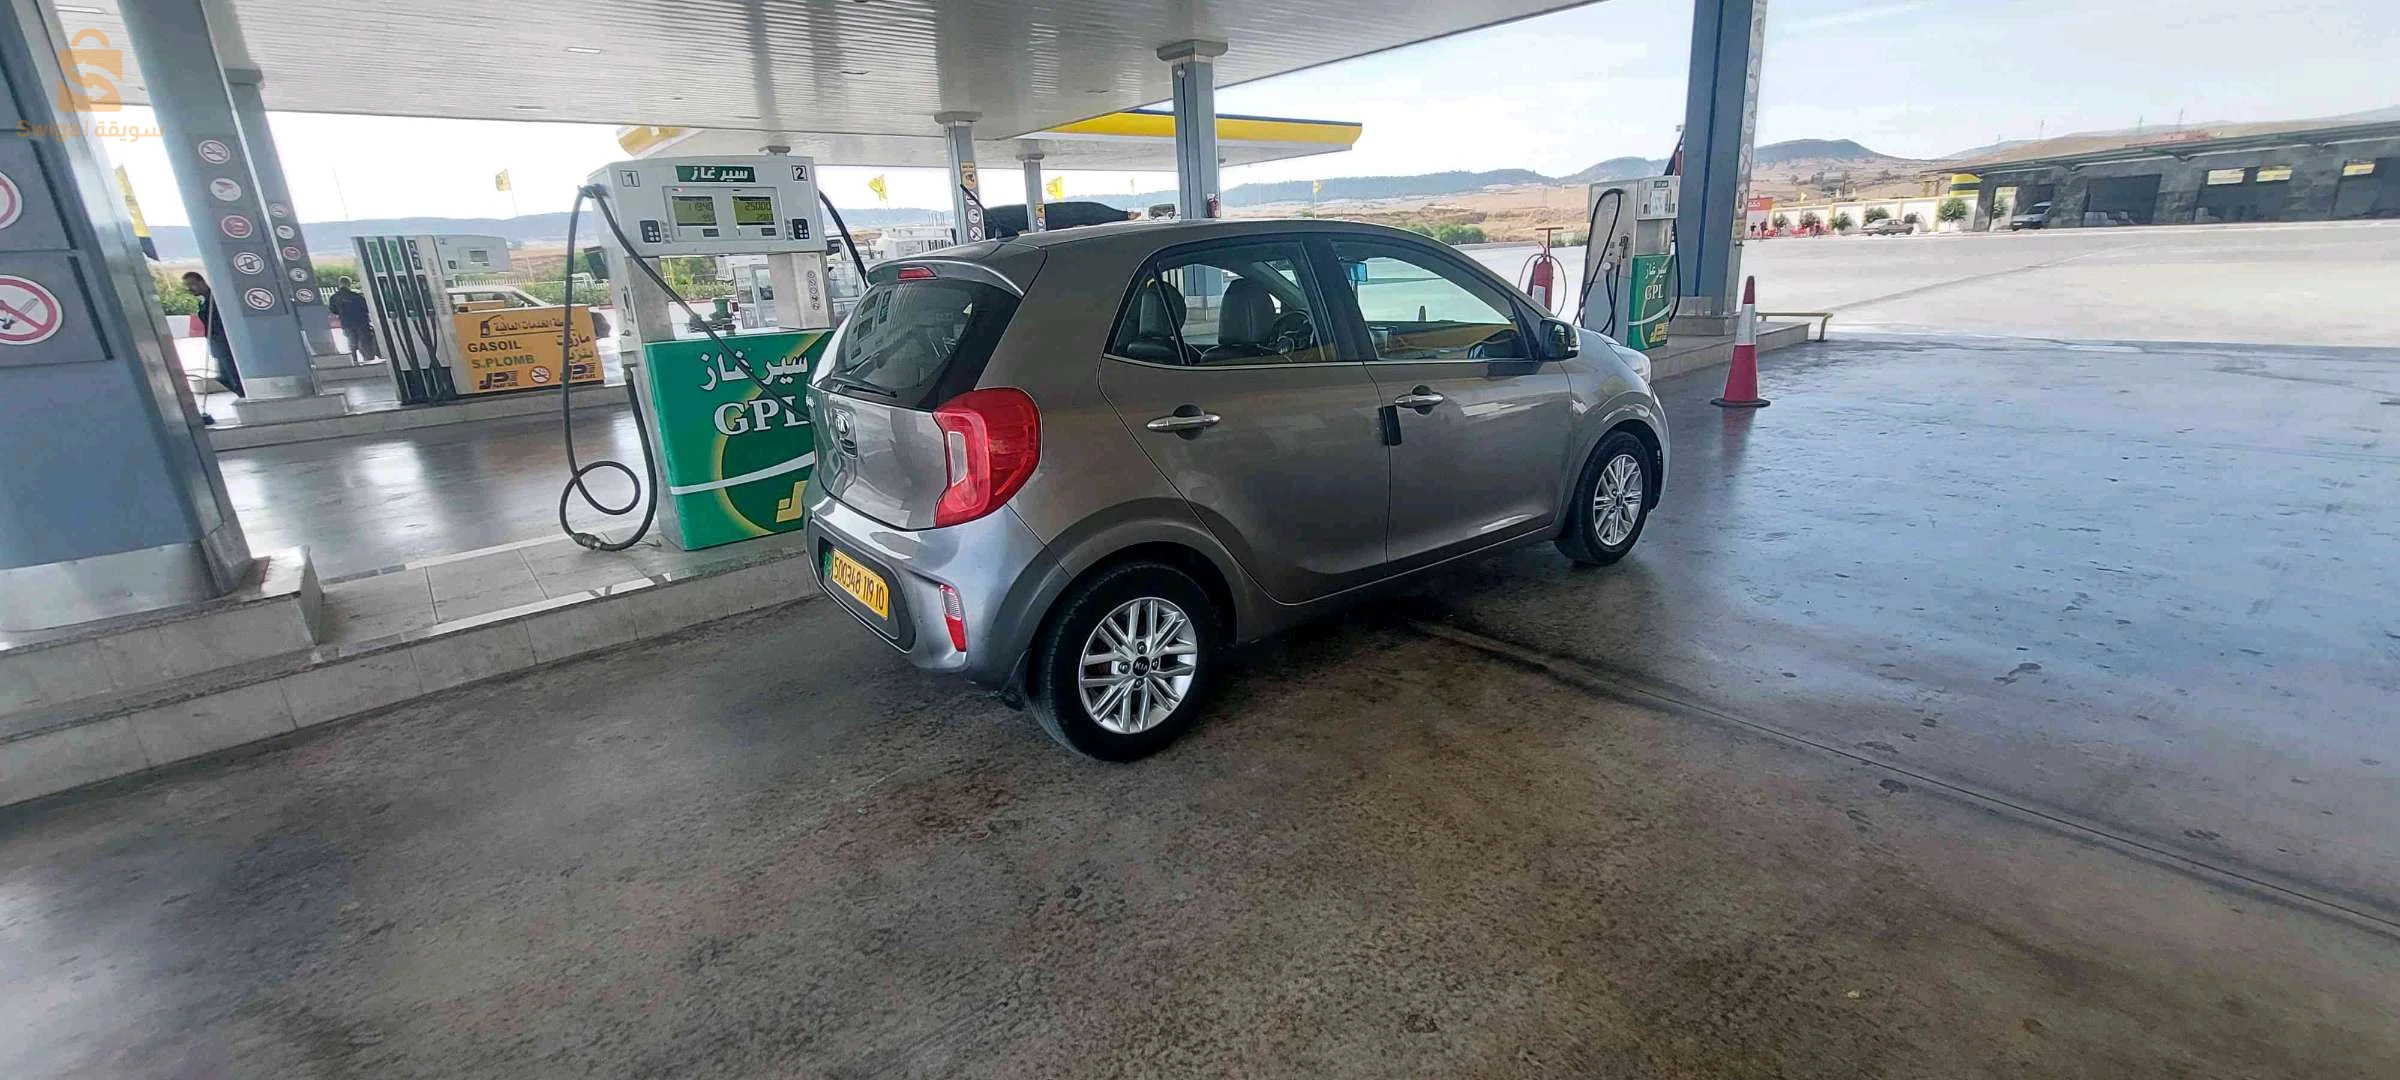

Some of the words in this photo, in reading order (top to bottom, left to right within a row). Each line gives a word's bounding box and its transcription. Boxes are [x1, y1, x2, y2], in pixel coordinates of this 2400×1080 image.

[690, 166, 716, 181] غاز
[719, 168, 749, 182] سير
[1644, 284, 1664, 300] GPL
[467, 340, 523, 353] GASOIL
[471, 354, 536, 369] S.PLOMB
[699, 350, 753, 391] غاز
[761, 355, 809, 386] سير
[714, 395, 810, 435] GPL
[875, 583, 885, 611] 10
[1134, 661, 1148, 671] KIA
